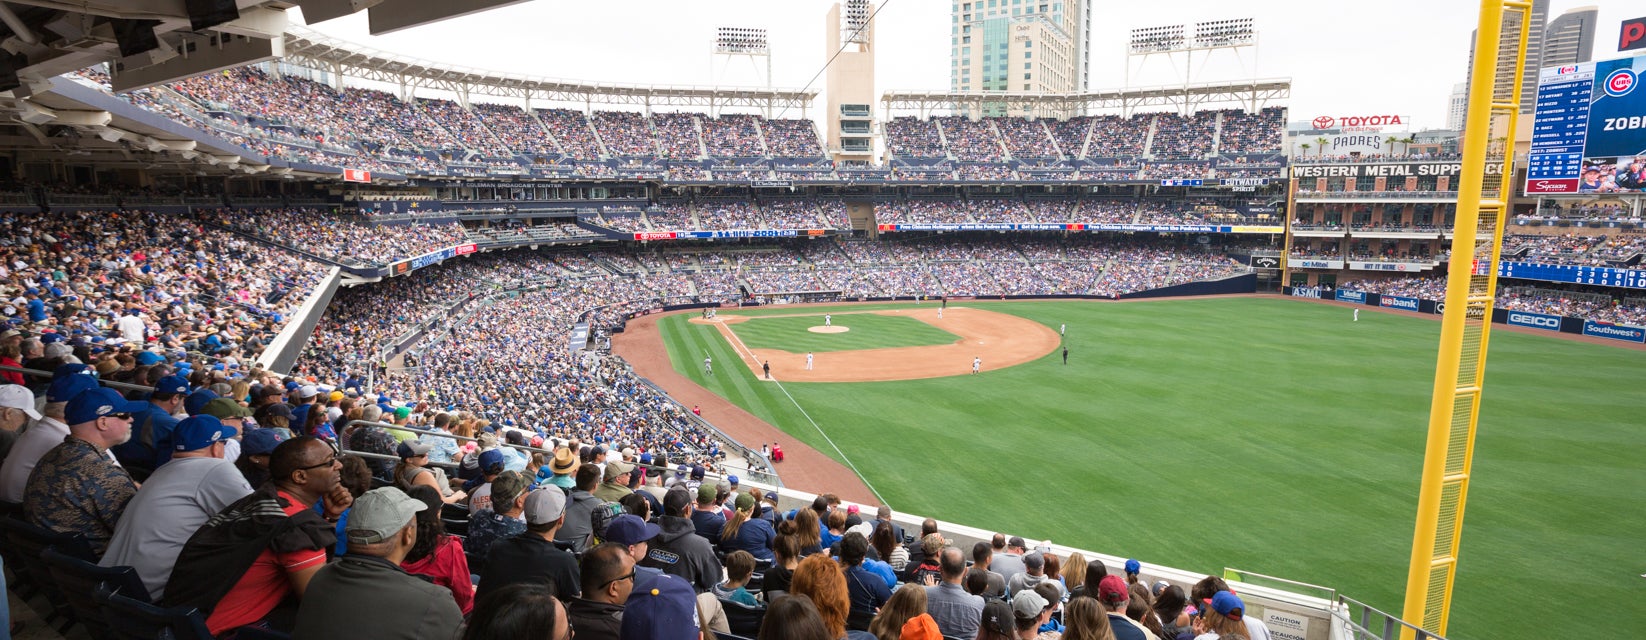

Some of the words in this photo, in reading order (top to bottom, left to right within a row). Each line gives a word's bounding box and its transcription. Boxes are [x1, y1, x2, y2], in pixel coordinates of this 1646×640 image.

[1621, 22, 1646, 48] p
[1340, 115, 1401, 127] TOYOTA
[1333, 136, 1380, 150] PADRES
[1294, 166, 1359, 177] WESTERN
[1365, 165, 1414, 176] METAL
[1418, 164, 1461, 175] SUPP
[1292, 287, 1321, 299] ASML
[1510, 314, 1558, 327] GEICO
[1588, 325, 1634, 337] Southwest
[1270, 615, 1301, 625] CAUTION
[1269, 629, 1305, 640] ECAUCIÓN
